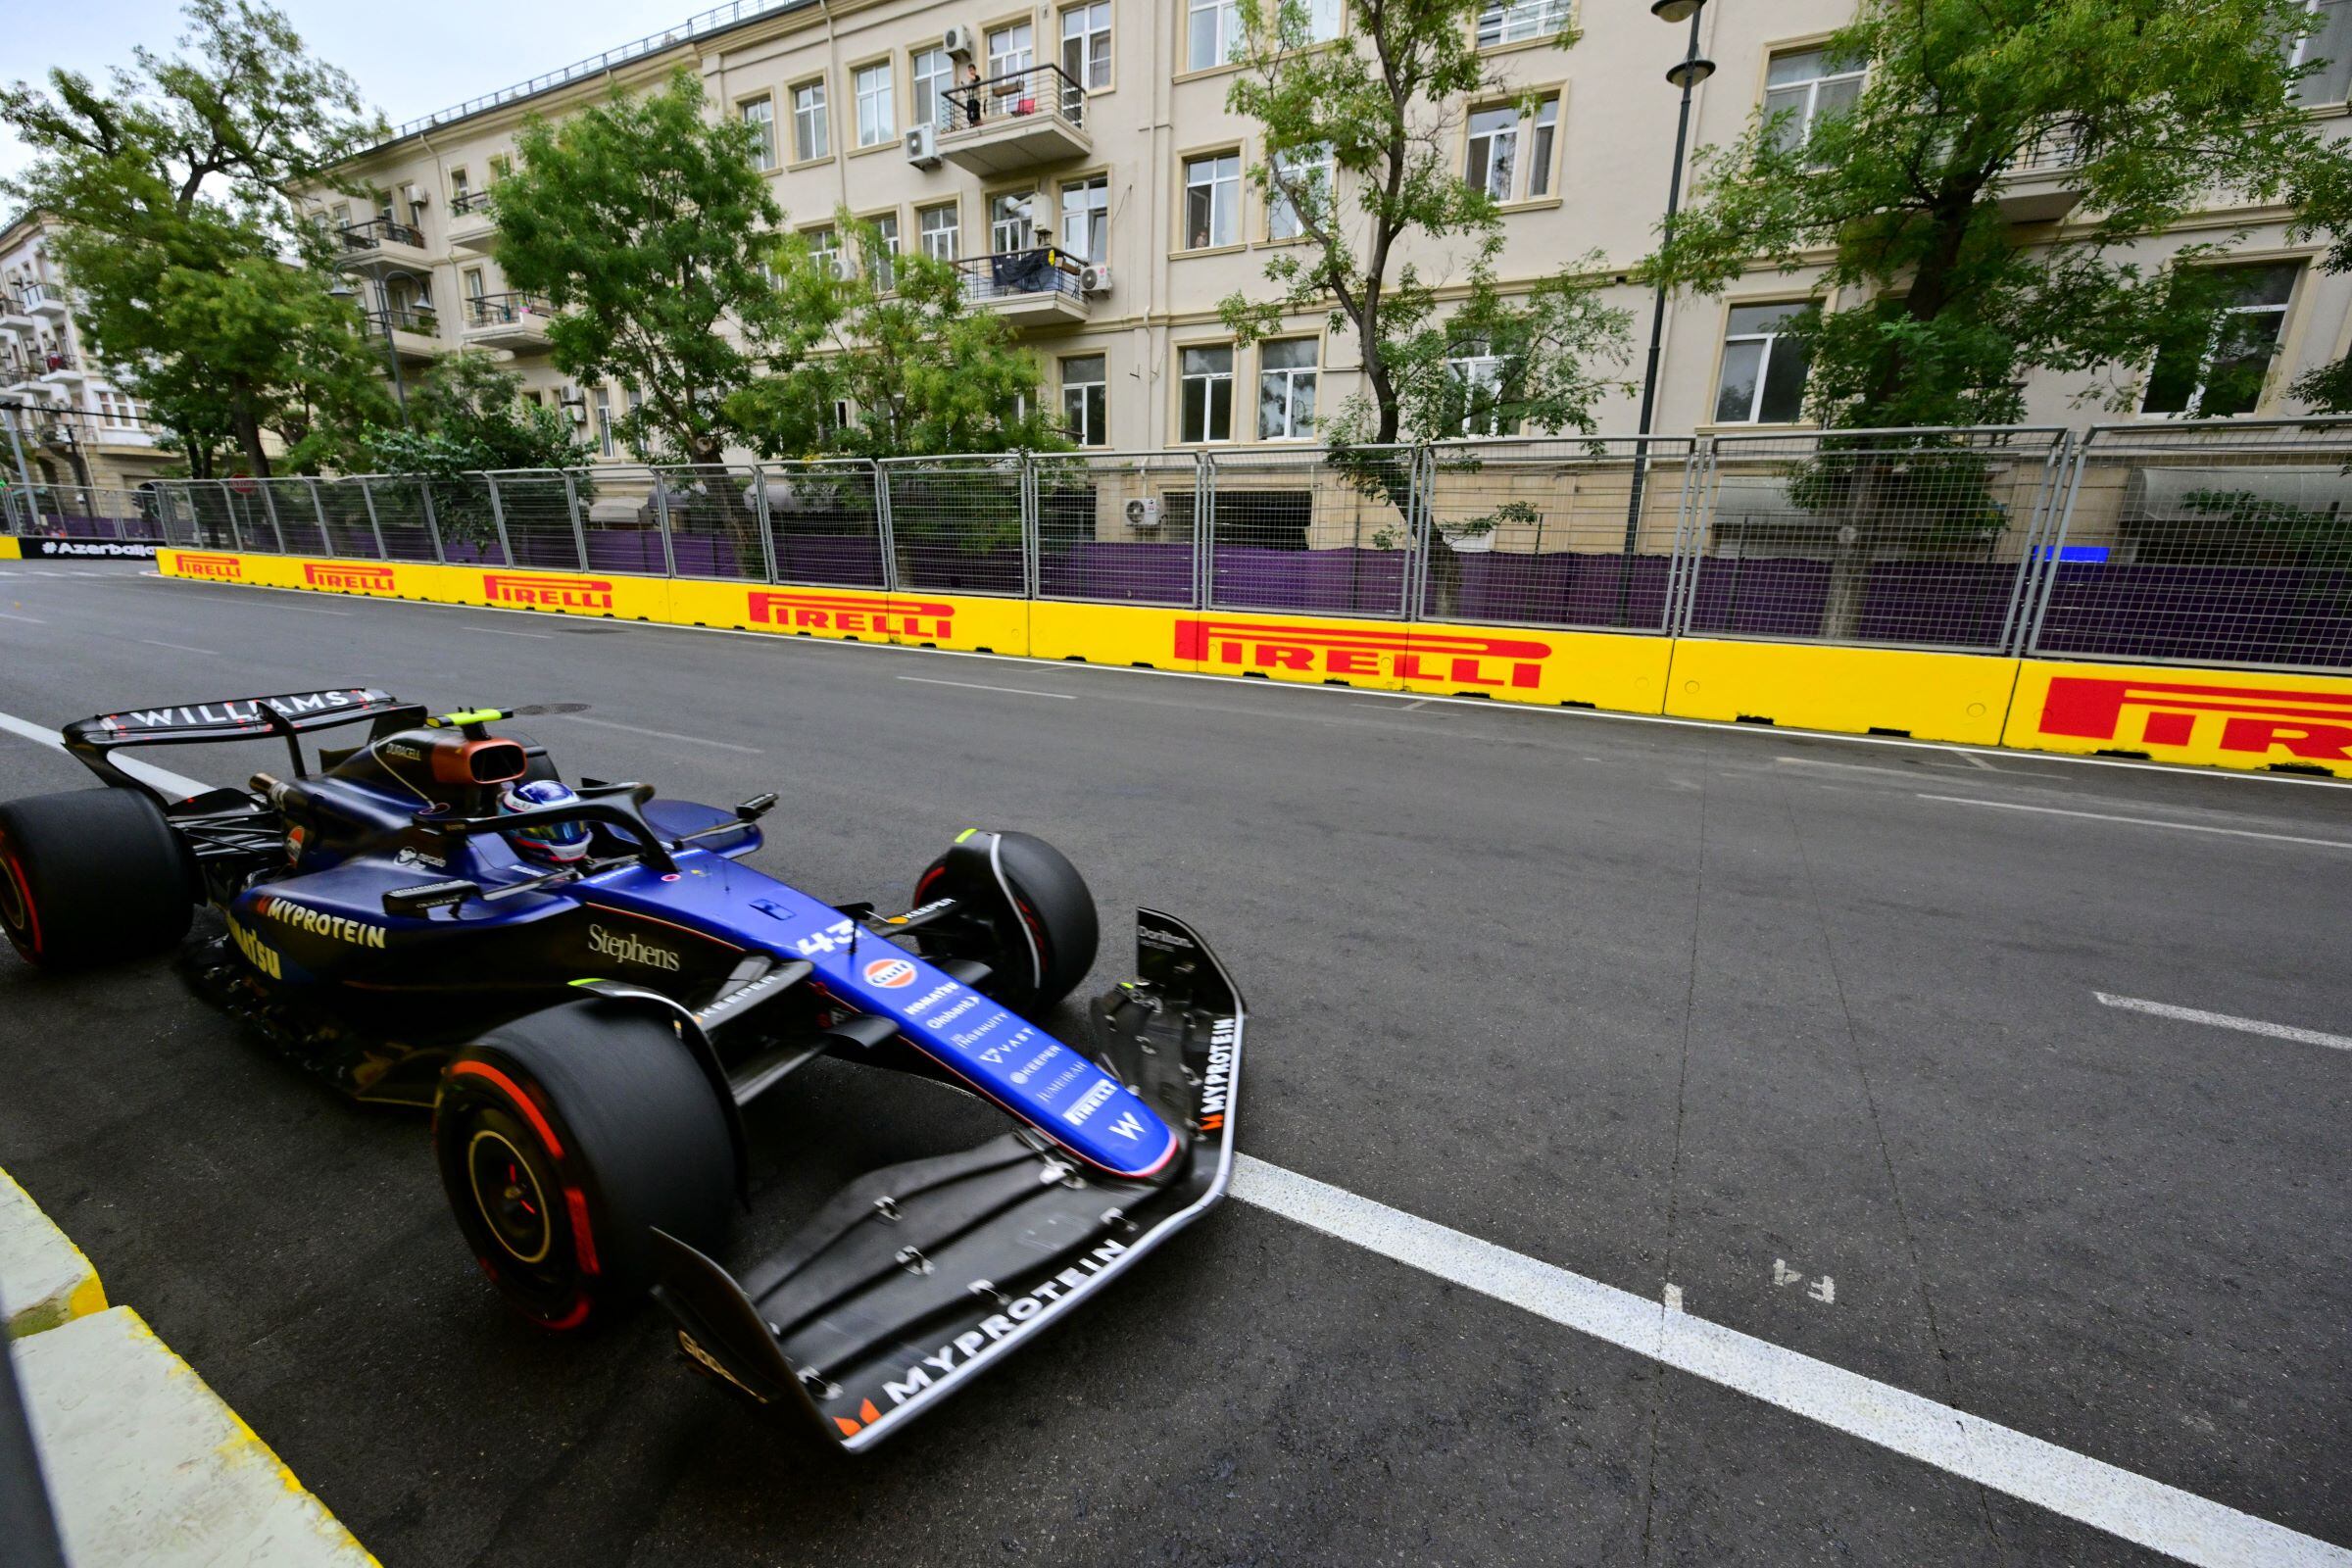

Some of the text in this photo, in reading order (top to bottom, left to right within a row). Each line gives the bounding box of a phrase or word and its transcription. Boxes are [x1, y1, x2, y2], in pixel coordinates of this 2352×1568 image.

[175, 554, 241, 577] PIRELLI
[304, 564, 395, 591] PIRELLI
[483, 574, 612, 609] PIRELLI
[748, 591, 956, 639] PIRELLI
[1173, 619, 1552, 689] PIRELLI
[268, 898, 386, 949] MYPROTEIN
[797, 918, 862, 956] 43
[588, 924, 680, 972] Stephens
[697, 975, 779, 1018] KEEPER
[904, 981, 959, 1015] KOMATSU
[998, 1027, 1036, 1053] VAST
[1019, 1045, 1062, 1076] KEEPER
[1200, 1018, 1235, 1113] MYPROTEIN
[1062, 1079, 1118, 1126] PIRELLI
[882, 1238, 1128, 1405] MYPROTEIN
